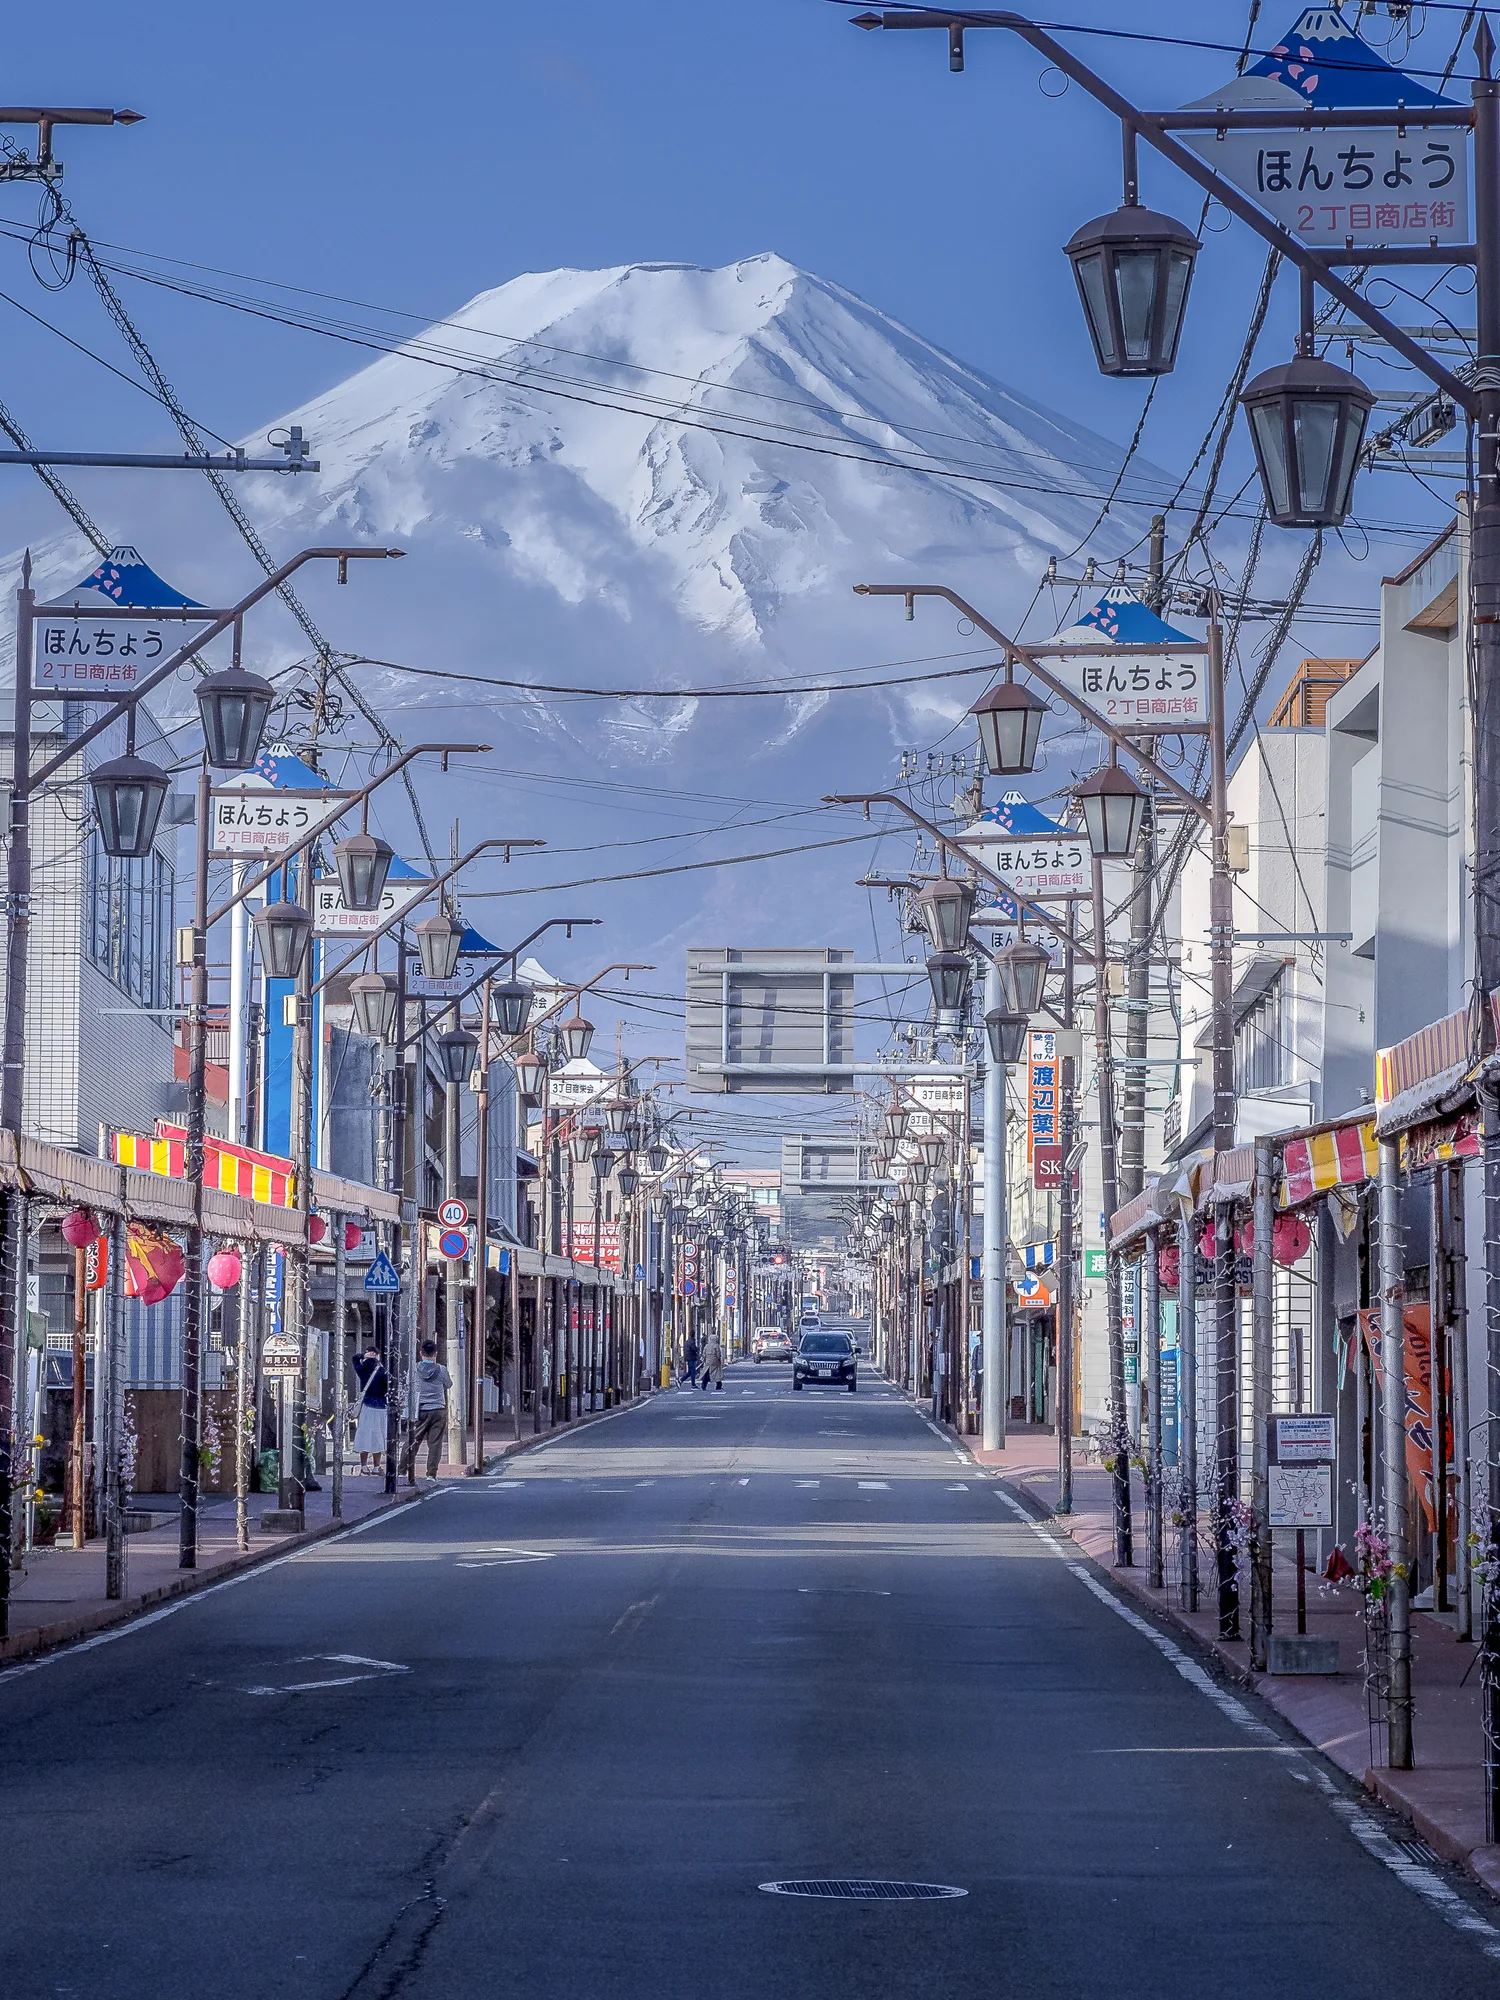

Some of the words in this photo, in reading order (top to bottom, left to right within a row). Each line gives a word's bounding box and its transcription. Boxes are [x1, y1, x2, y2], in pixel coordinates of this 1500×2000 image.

[1257, 143, 1455, 192] ほんちょう
[1297, 202, 1455, 230] 2丁目商店街
[44, 628, 163, 657] ほんちょう
[43, 662, 138, 681] 2丁目商店街
[1082, 663, 1197, 692] ほんちょう
[1106, 697, 1198, 715] 2丁目商店街
[218, 804, 309, 827] ほんちょう
[217, 830, 290, 844] 2丁目商店街
[997, 847, 1082, 871] ほんちょう
[1015, 873, 1083, 888] 2丁目商店街
[320, 892, 394, 910] ほんう
[319, 914, 380, 925] 2丁目商店街
[412, 962, 475, 978] ほょう
[445, 1207, 461, 1220] 40
[1124, 1270, 1135, 1317] 渡辺歯科
